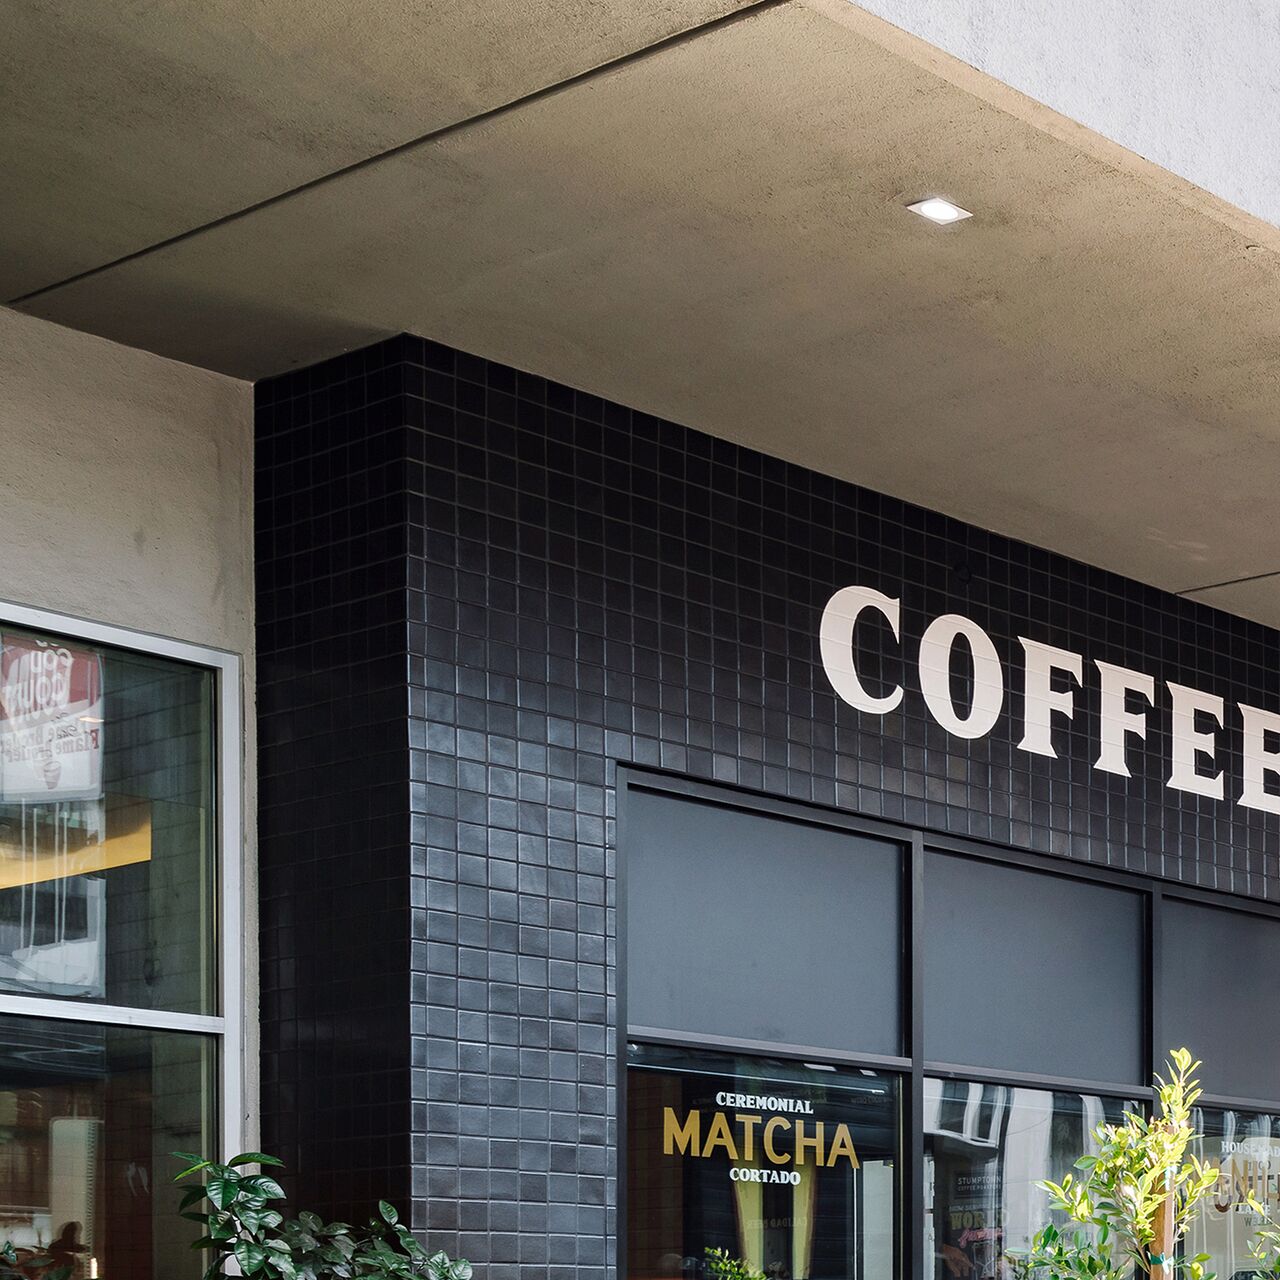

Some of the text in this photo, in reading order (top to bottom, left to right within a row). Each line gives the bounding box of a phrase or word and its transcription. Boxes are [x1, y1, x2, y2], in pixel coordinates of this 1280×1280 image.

[715, 1091, 813, 1115] CEREMONIAL
[663, 1106, 860, 1169] MATCHA
[729, 1166, 802, 1186] CORTADO
